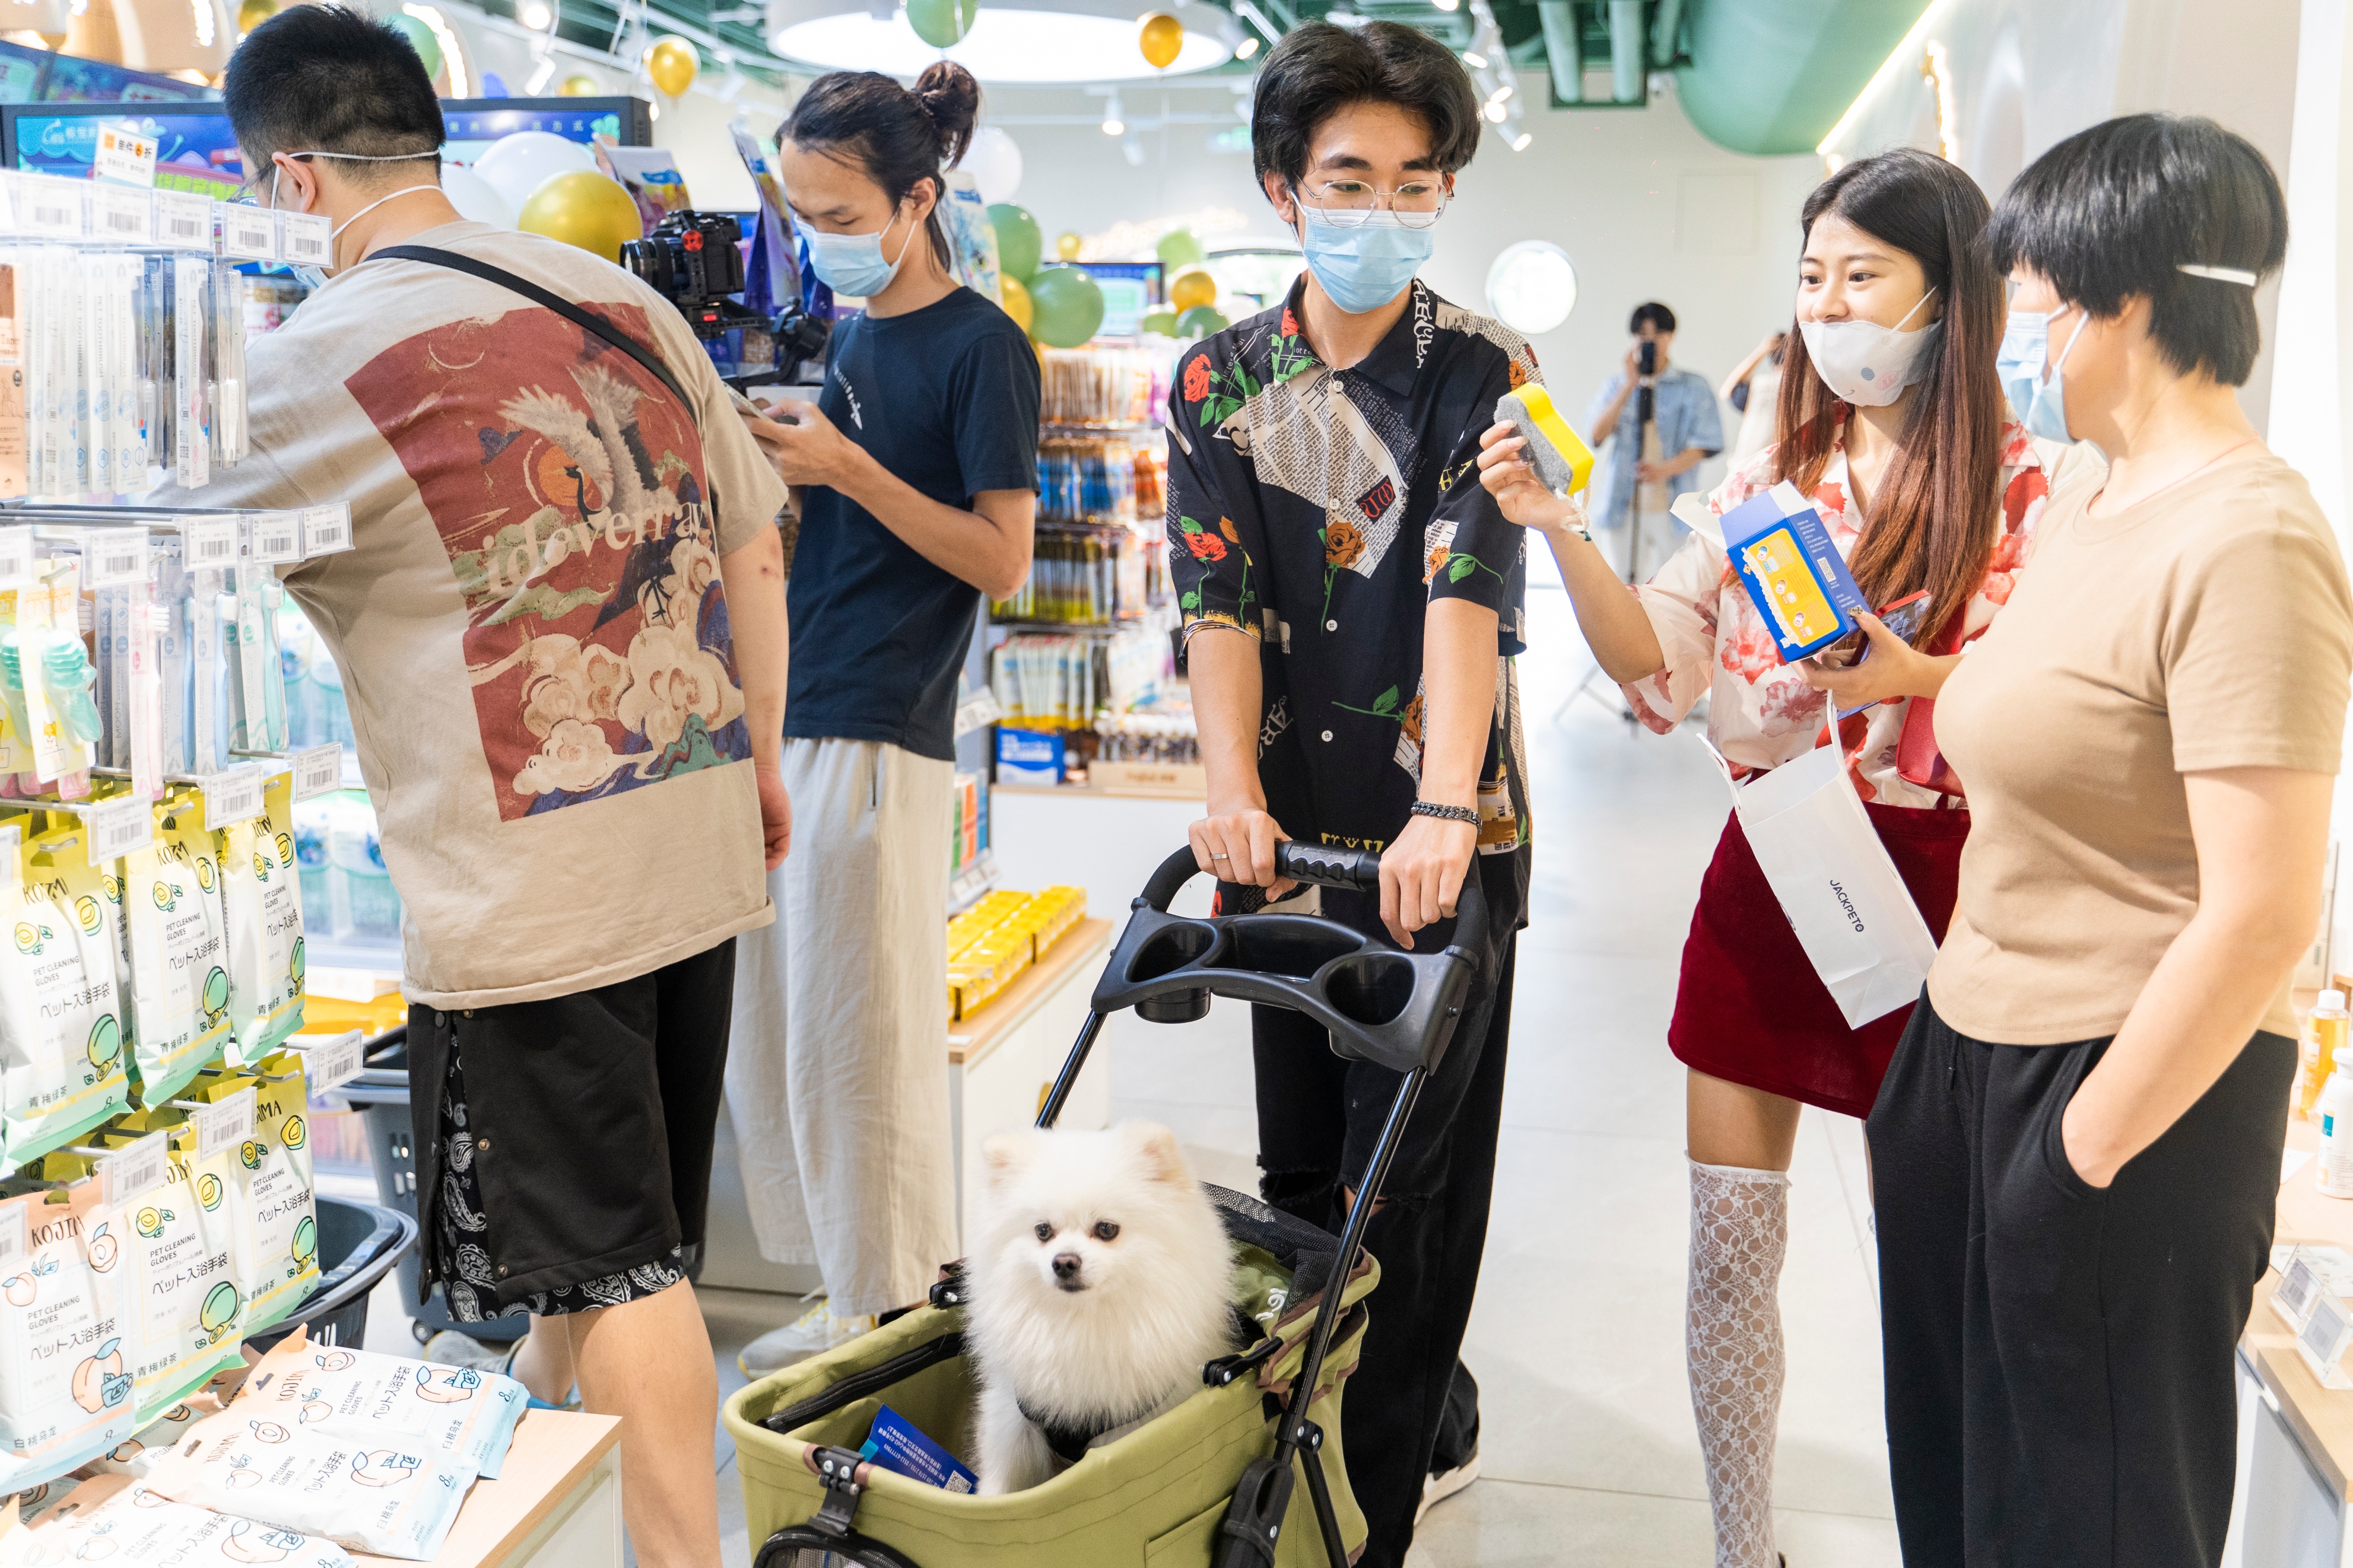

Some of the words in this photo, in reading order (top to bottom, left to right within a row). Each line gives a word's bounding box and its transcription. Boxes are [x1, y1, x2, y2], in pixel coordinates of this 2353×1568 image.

[166, 923, 175, 932] PET
[176, 913, 201, 928] CLEANING
[167, 929, 186, 941] GLOVES
[34, 966, 46, 977] PET
[47, 956, 80, 971] CLEANING
[36, 973, 59, 986] GLOVES
[253, 1179, 262, 1188] PET
[262, 1168, 285, 1183] CLEANING
[255, 1184, 272, 1196] GLOVES
[150, 1248, 163, 1258] PET
[164, 1233, 196, 1252] CLEANING
[150, 1251, 177, 1267] GLOVES
[153, 1252, 228, 1295] ペット入浴手袋
[28, 1309, 42, 1320] PET
[45, 1296, 80, 1313] CLEANING
[29, 1314, 58, 1330] GLOVES
[31, 1318, 115, 1360] ペット入浴手袋
[137, 1353, 177, 1378] 青梅绿茶
[339, 1405, 348, 1414] PET
[344, 1381, 362, 1405] CLEANING
[373, 1366, 411, 1419] ペット入浴手袋
[498, 1392, 511, 1402] 8
[348, 1396, 363, 1415] GLOVES
[14, 1425, 57, 1449] 白桃乌龙
[442, 1419, 462, 1449] 白桃乌龙
[274, 1455, 296, 1475] CLEANING
[304, 1451, 348, 1493] ペット入浴手袋
[279, 1470, 295, 1486] GLOVES
[439, 1475, 450, 1487] 8
